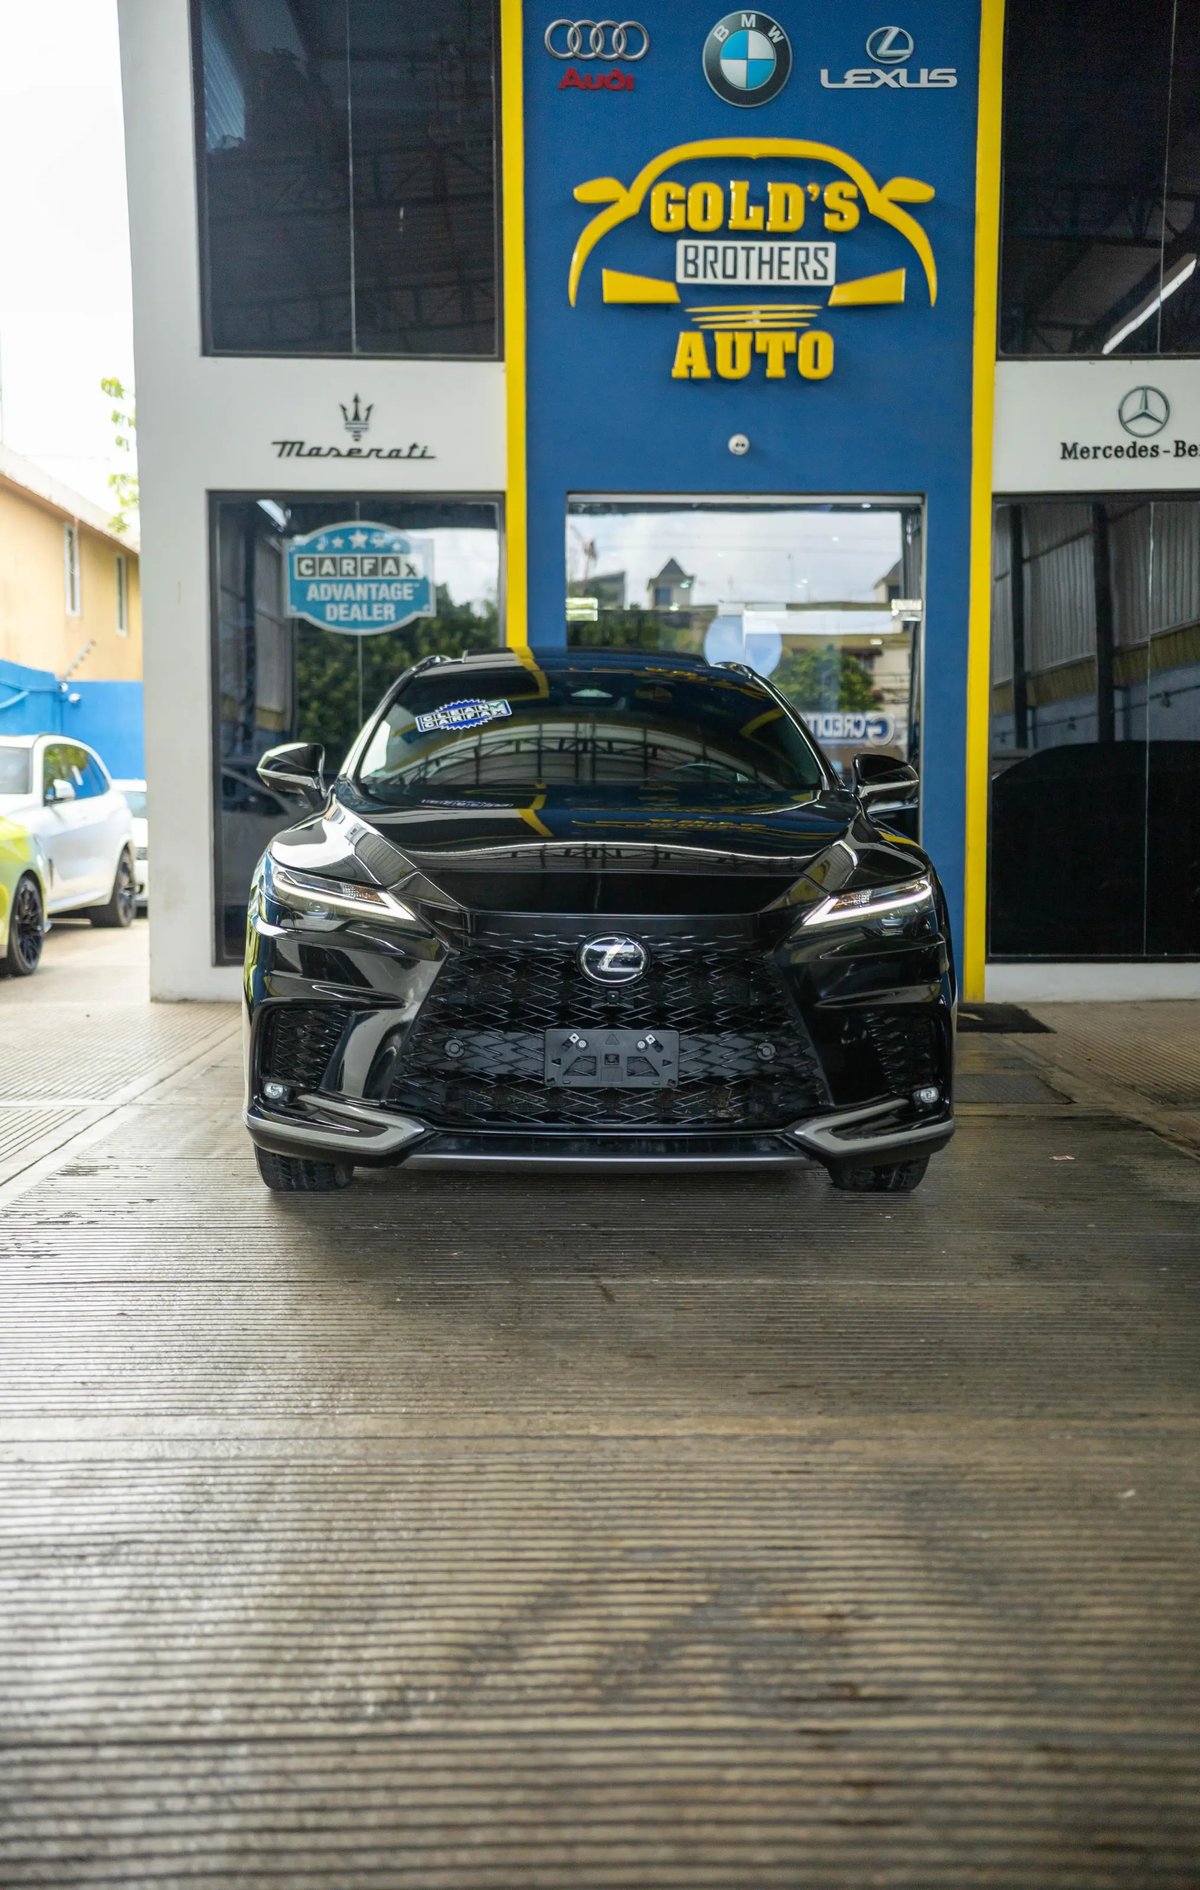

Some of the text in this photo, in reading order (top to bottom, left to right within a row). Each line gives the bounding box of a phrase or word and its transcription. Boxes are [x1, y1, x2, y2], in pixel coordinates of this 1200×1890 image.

[713, 13, 784, 43] BMW
[558, 67, 635, 91] Audi
[820, 67, 958, 89] LEXUS
[650, 180, 860, 233] GOLD'S
[683, 244, 829, 281] BROTHERS
[671, 330, 835, 380] AUTO
[271, 440, 436, 459] Maserati
[1060, 439, 1200, 460] Mercedes-Be
[298, 556, 418, 578] CARFAX
[325, 603, 397, 621] DEALER
